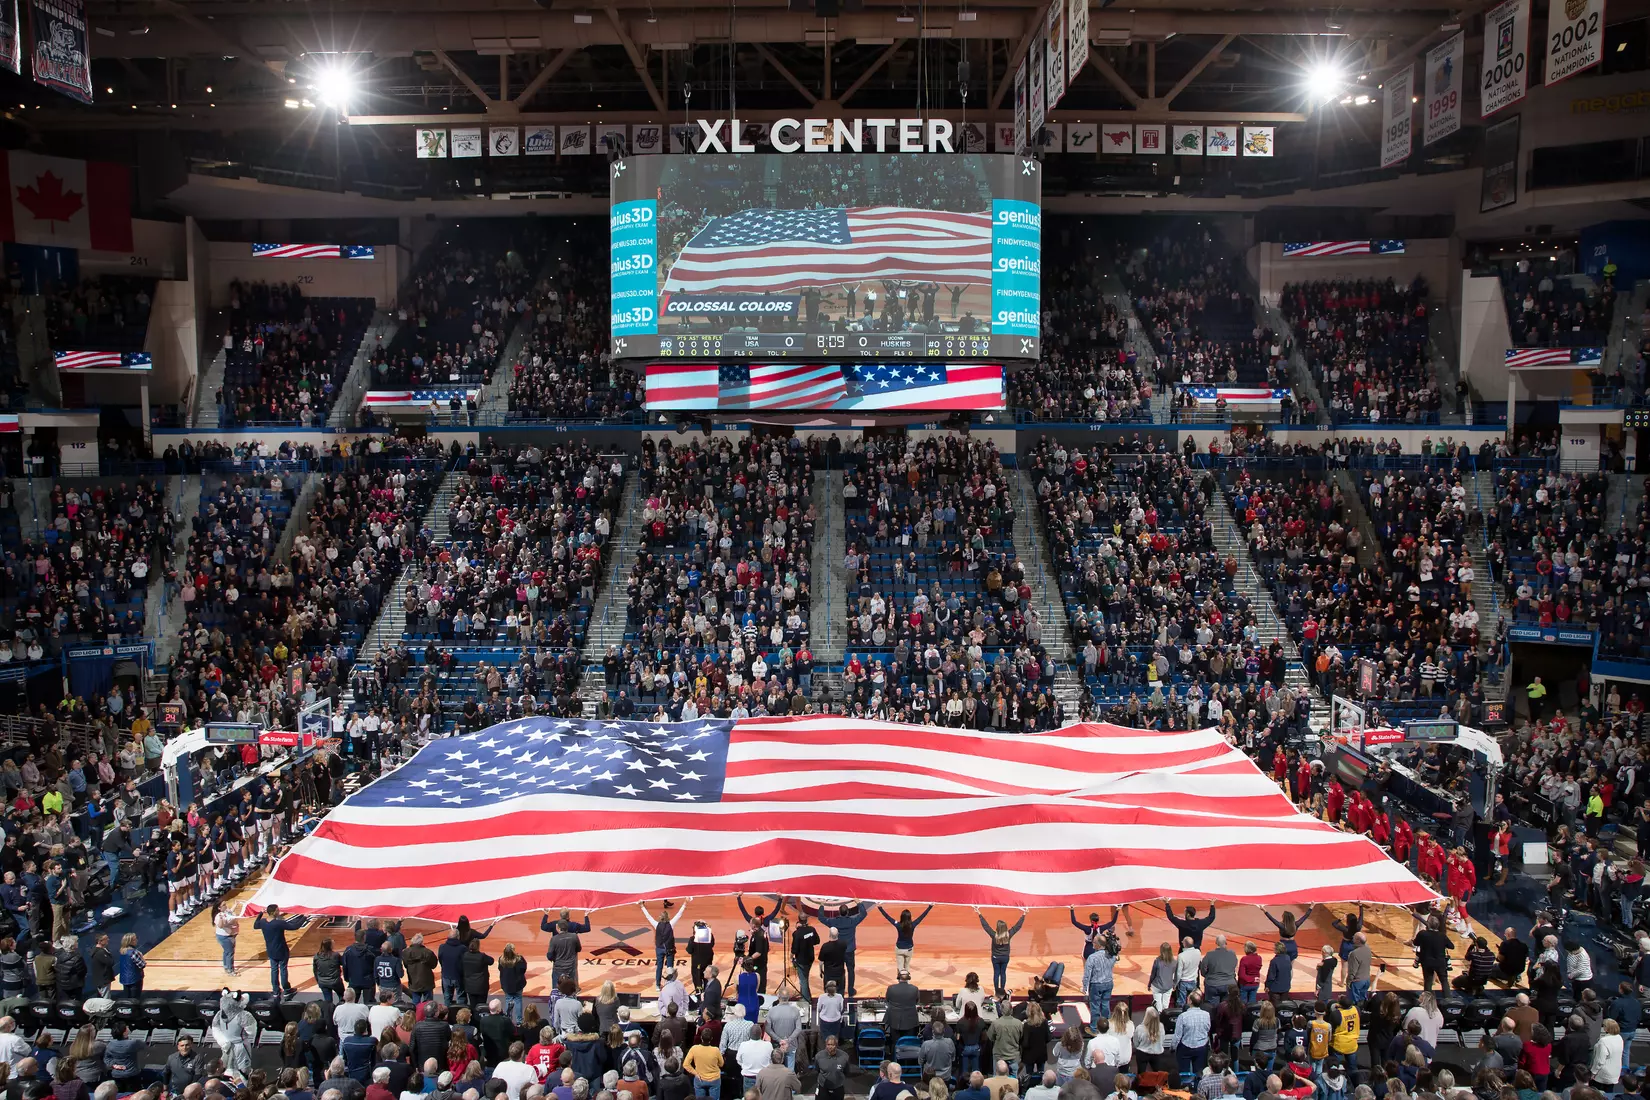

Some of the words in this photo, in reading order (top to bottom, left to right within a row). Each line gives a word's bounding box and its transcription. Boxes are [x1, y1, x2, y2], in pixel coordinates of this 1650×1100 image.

[1551, 12, 1599, 55] 2002
[1554, 42, 1593, 66] NATIONAL
[1484, 52, 1525, 90] 2000
[1550, 53, 1596, 81] CHAMPIONS
[1488, 79, 1519, 100] NATIONAL
[1428, 90, 1457, 120] 1999
[1485, 89, 1521, 113] CHAMPIONS
[1429, 114, 1456, 131] NATIONAL
[696, 118, 755, 153] XL
[770, 117, 954, 153] CENTER
[1386, 118, 1410, 143] 1995
[1426, 124, 1457, 143] CHAMPIONS
[1208, 136, 1235, 147] Tulsa
[1386, 140, 1409, 153] NATIONAL
[1593, 244, 1607, 257] 220
[130, 256, 149, 266] 241
[298, 276, 314, 284] 212
[667, 301, 736, 312] COLOSSAL
[738, 301, 793, 312] COLORS
[785, 336, 794, 347] 0
[817, 335, 845, 348] 8:09
[858, 336, 868, 347] 0
[71, 442, 86, 450] 112
[1570, 438, 1585, 446] 119
[165, 714, 176, 723] 24
[1488, 712, 1499, 720] 24
[217, 728, 248, 739] COX
[1416, 726, 1447, 737] COX
[583, 958, 606, 966] XL
[611, 958, 688, 966] CENR
[376, 966, 393, 978] 30
[1316, 1033, 1324, 1043] 8
